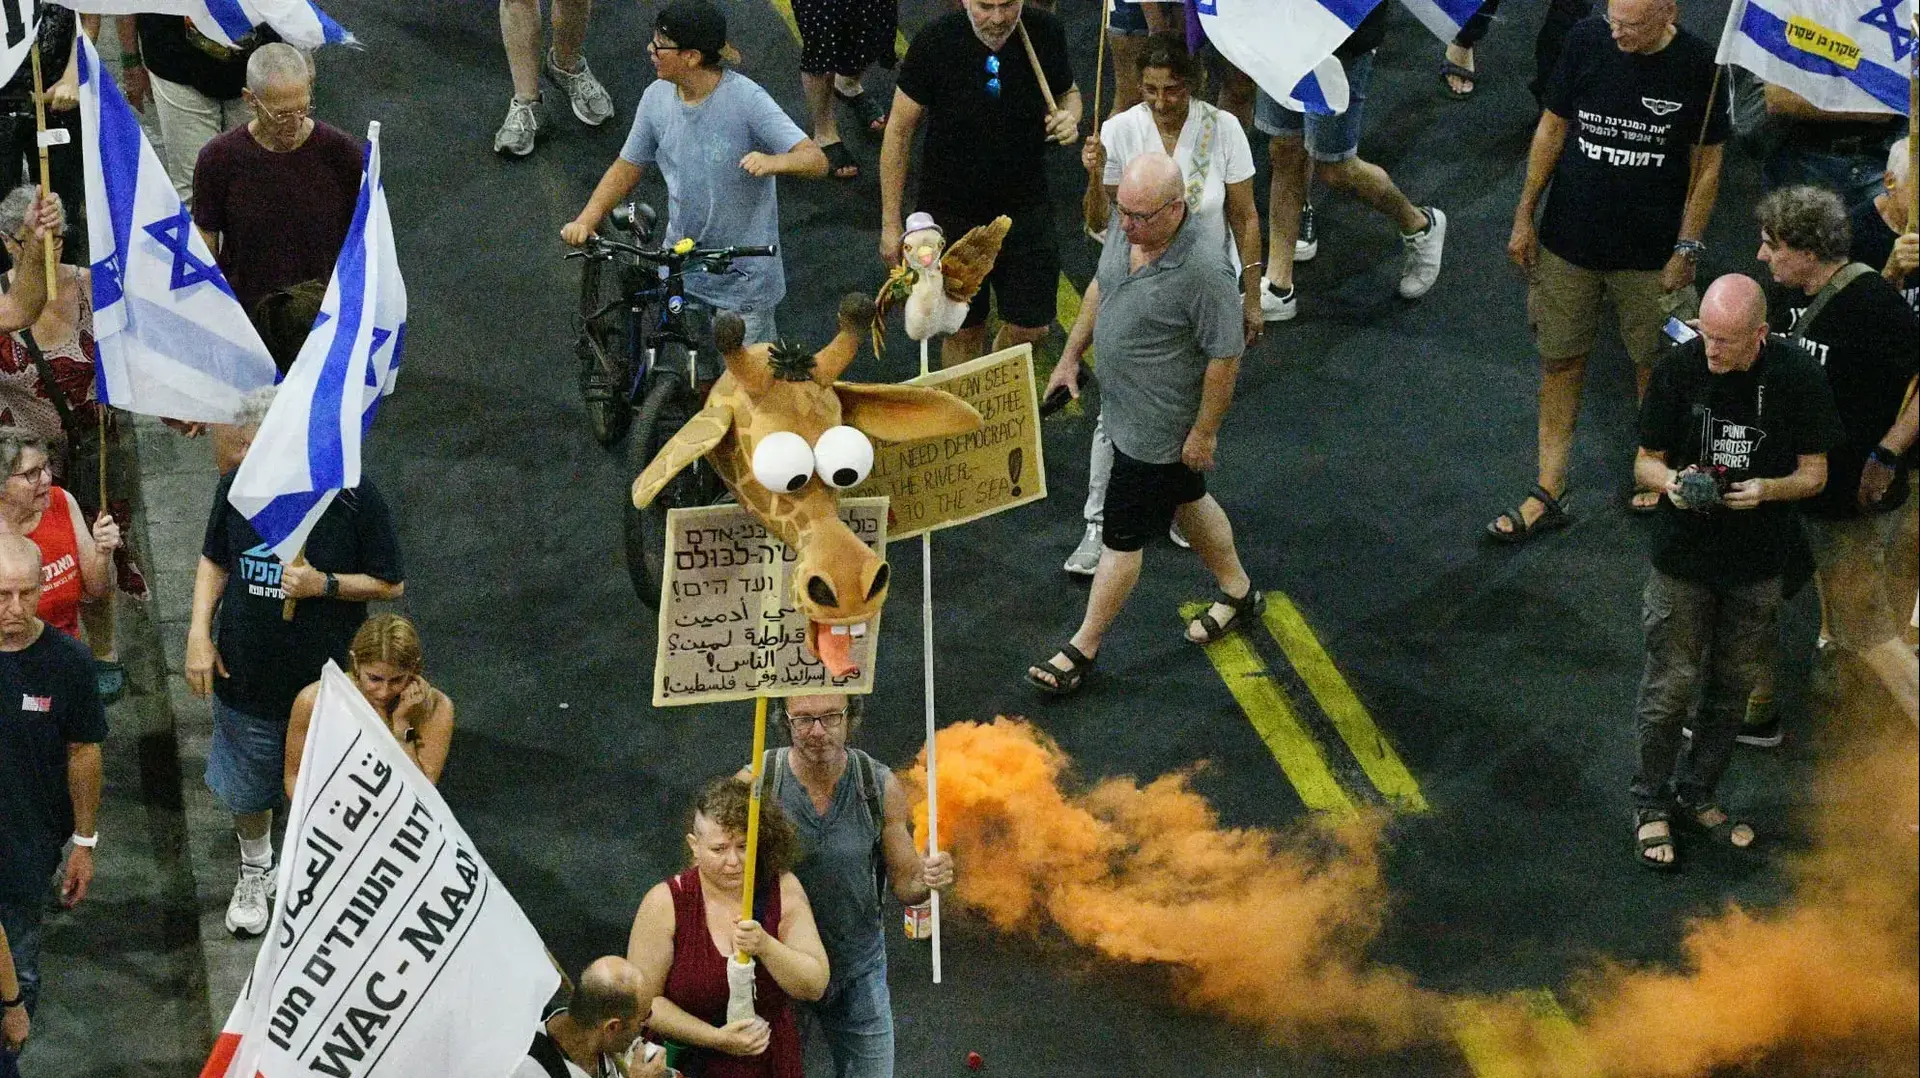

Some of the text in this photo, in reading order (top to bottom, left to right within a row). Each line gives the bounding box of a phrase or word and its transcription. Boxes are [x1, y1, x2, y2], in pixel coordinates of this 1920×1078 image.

[1788, 24, 1860, 59] שקרן בן שקרן
[1605, 116, 1647, 130] המנגינה
[1713, 438, 1753, 454] PROTEST
[332, 748, 393, 832] قابة
[267, 797, 434, 1052] רגון העובדים מען
[309, 970, 408, 1078] WAC
